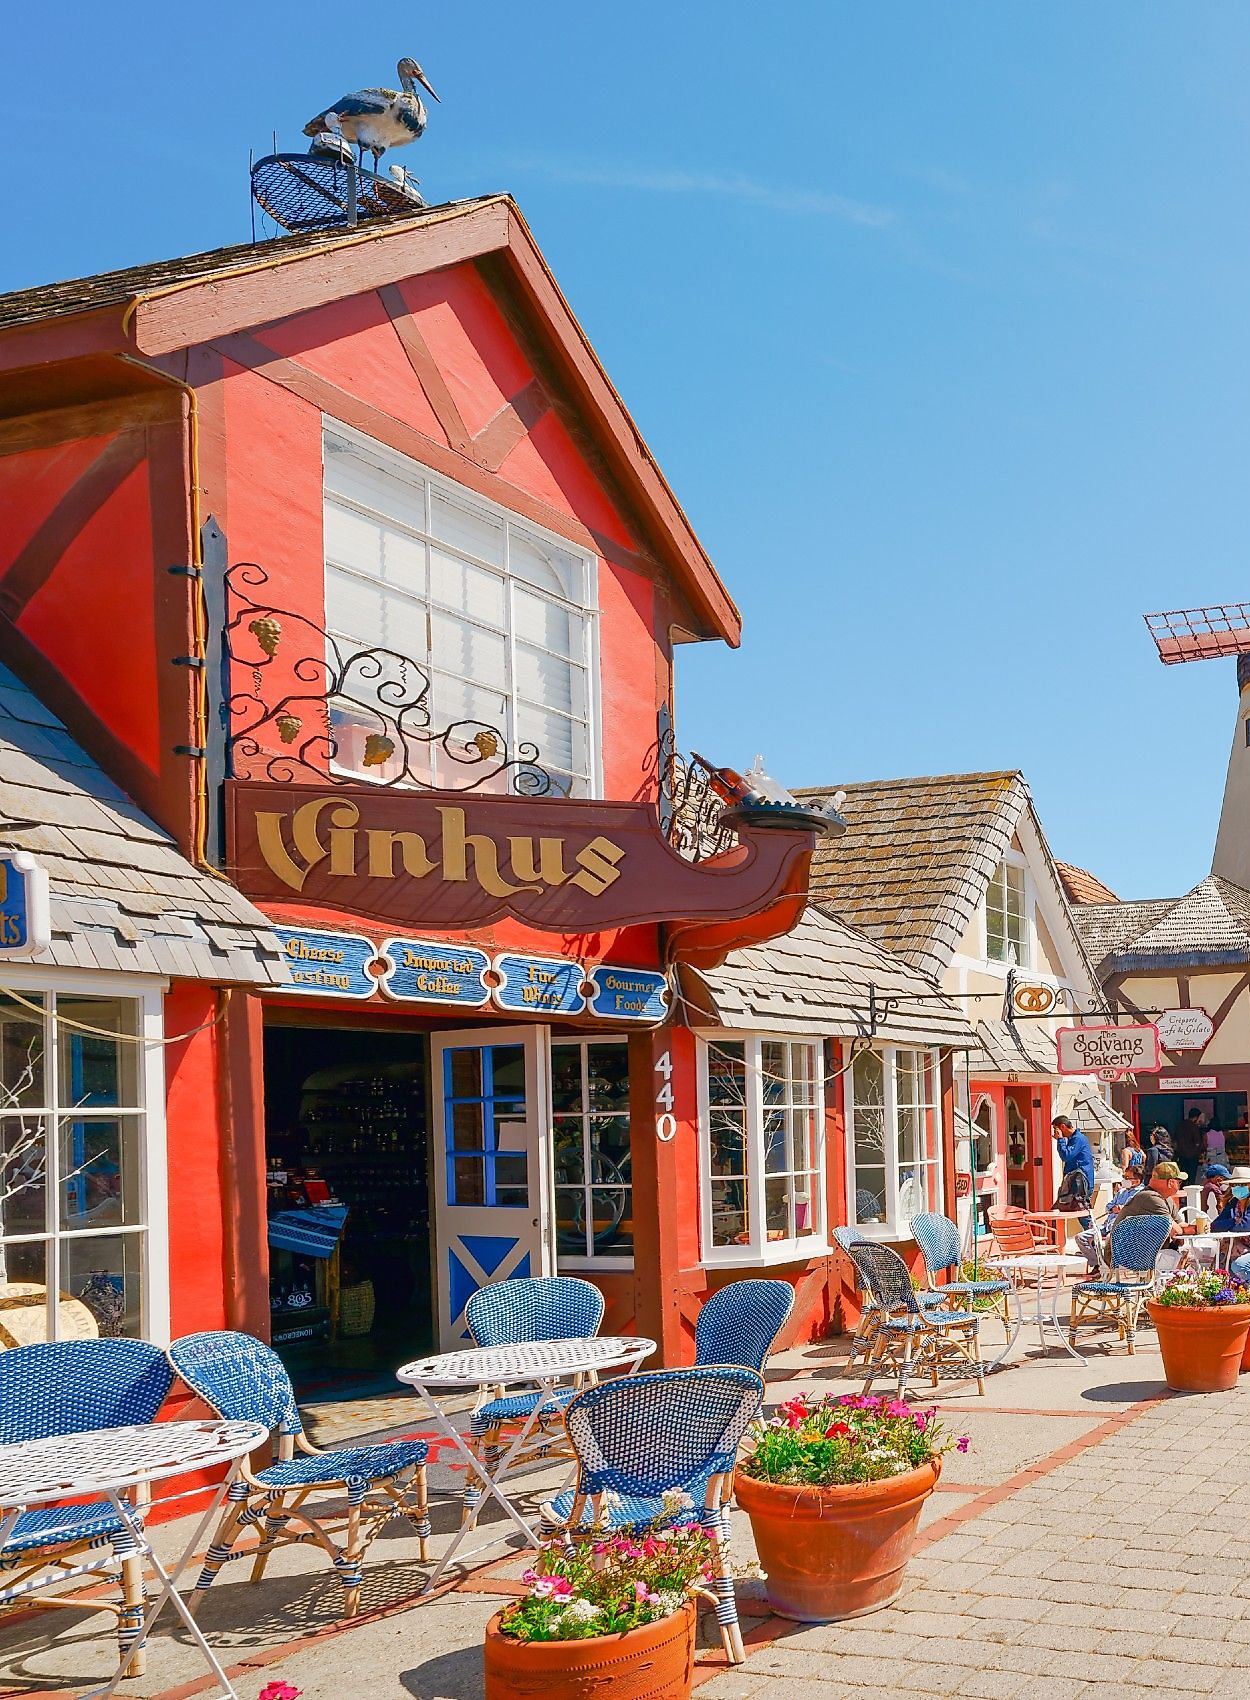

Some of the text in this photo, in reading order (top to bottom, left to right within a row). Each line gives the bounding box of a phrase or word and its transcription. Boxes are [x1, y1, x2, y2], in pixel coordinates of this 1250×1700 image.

[255, 797, 626, 897] Vinhus
[285, 938, 344, 963] Cheese
[403, 949, 473, 973] Imported
[288, 963, 349, 989] asting
[417, 974, 460, 995] Coffee
[529, 965, 557, 985] Fine
[606, 976, 654, 993] Gourmet
[523, 986, 561, 1006] Wines
[616, 995, 647, 1012] Foods
[1184, 1023, 1210, 1035] Gelato
[1073, 1034, 1143, 1055] Solvang
[1083, 1051, 1135, 1067] Bakery
[655, 1051, 676, 1142] 440
[287, 1293, 312, 1306] 805
